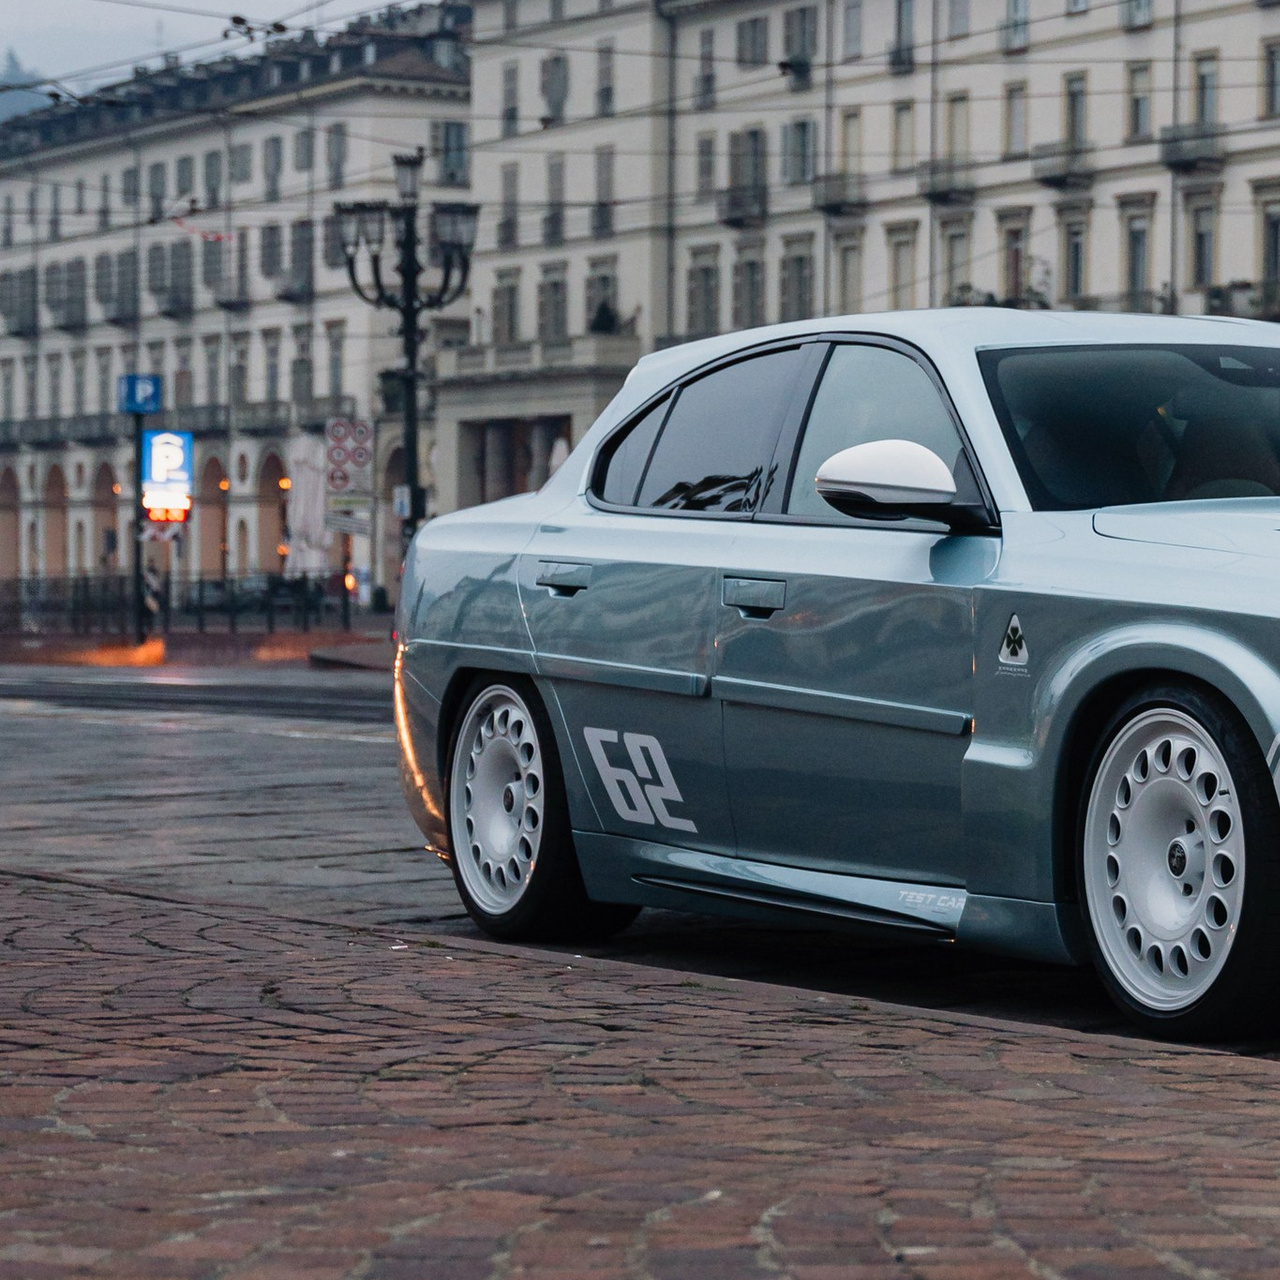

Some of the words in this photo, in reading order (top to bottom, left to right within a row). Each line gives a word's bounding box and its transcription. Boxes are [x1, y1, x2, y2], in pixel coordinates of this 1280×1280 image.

[135, 380, 154, 404] P
[151, 443, 184, 483] P
[583, 726, 698, 833] 62
[899, 891, 936, 904] TEST
